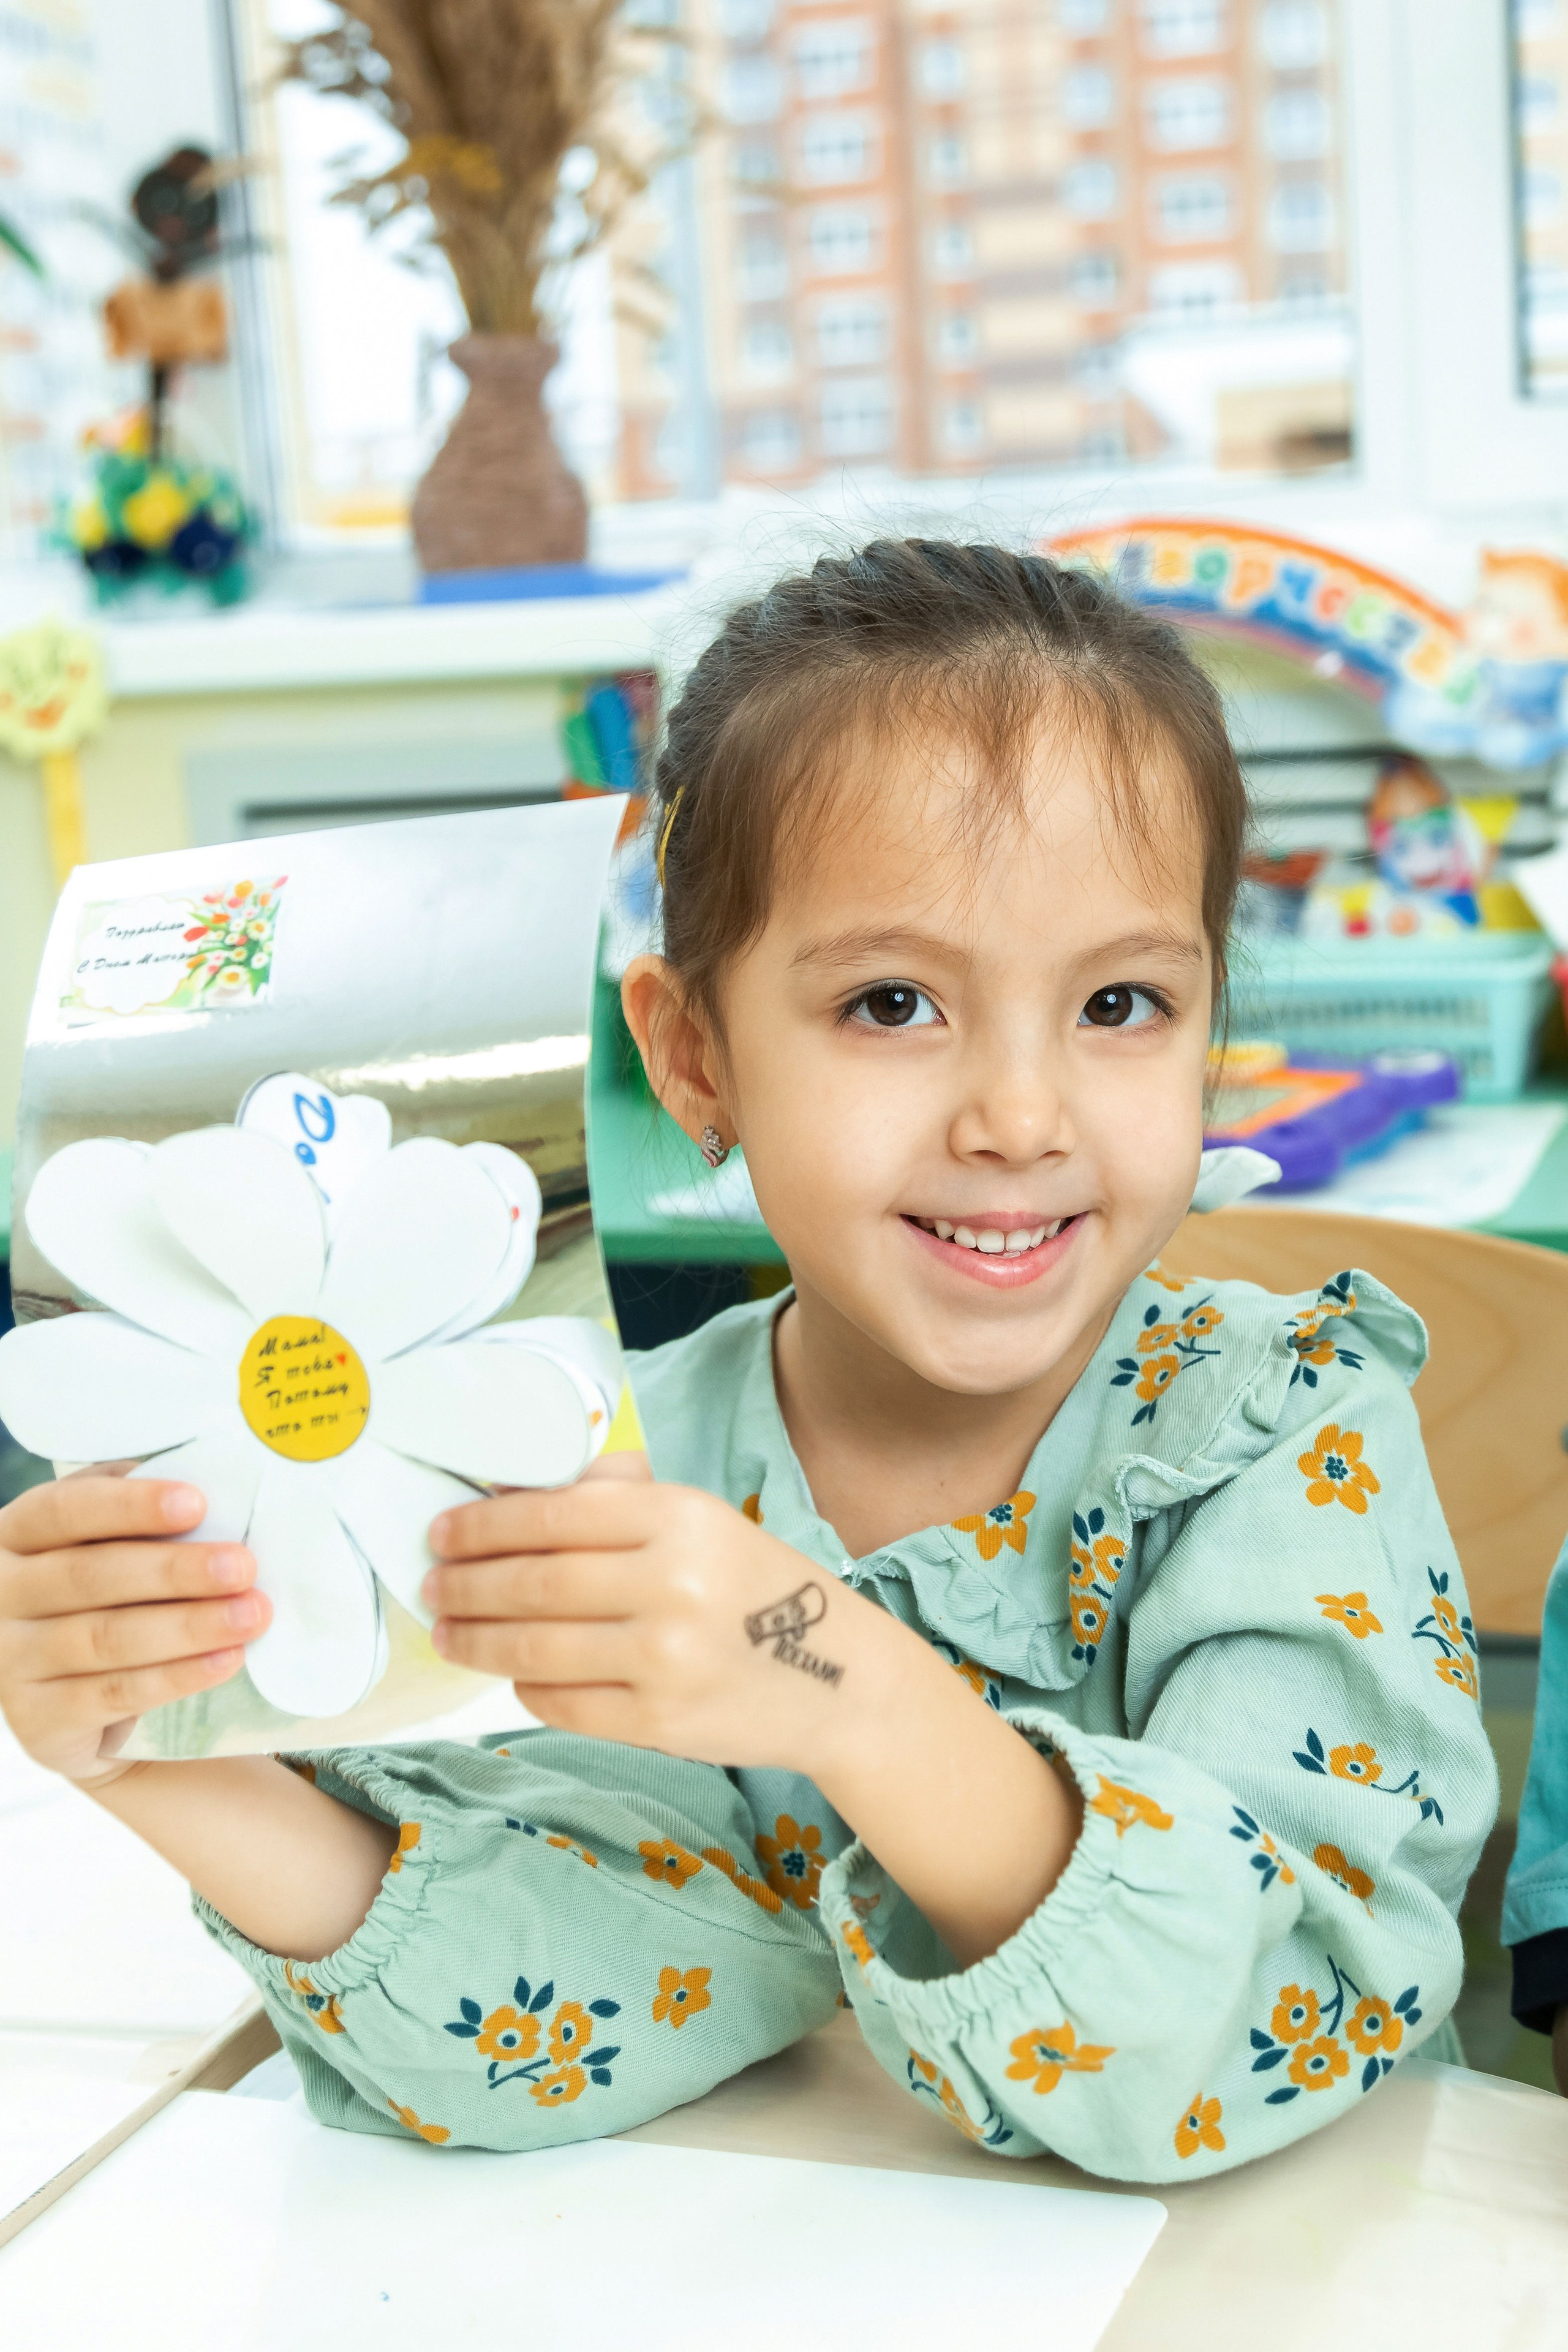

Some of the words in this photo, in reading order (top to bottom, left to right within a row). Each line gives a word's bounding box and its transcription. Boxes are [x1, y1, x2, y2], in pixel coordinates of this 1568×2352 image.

[77, 960, 89, 974] С
[254, 1366, 275, 1387] Я
[266, 1382, 349, 1409] Потому
[265, 1422, 301, 1438] что
[311, 1414, 339, 1428] ты
